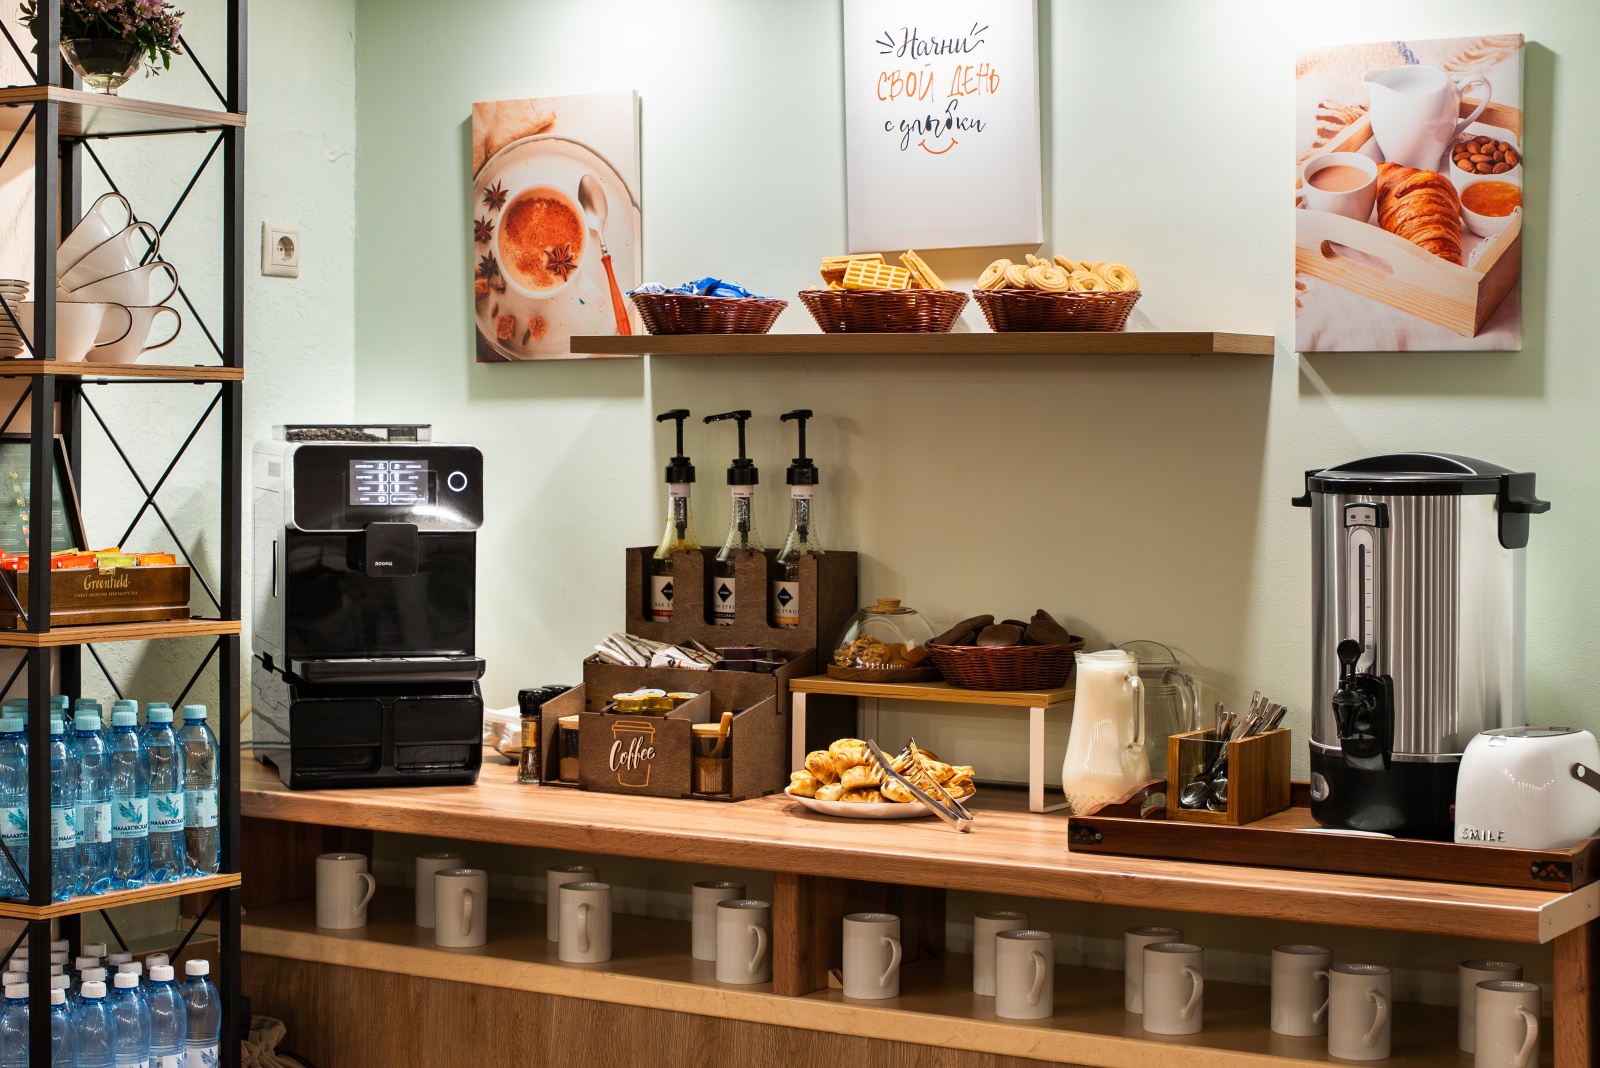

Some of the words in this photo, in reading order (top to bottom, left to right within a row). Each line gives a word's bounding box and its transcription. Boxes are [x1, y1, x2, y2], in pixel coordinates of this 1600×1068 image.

[896, 27, 985, 60] Начни
[877, 63, 936, 103] СВОЙ
[947, 63, 1000, 99] ДЕНЬ
[884, 120, 895, 132] с
[899, 98, 987, 151] улыбки
[83, 573, 129, 591] Greenfield
[609, 736, 655, 772] Coffee
[1461, 828, 1506, 843] SMILE
